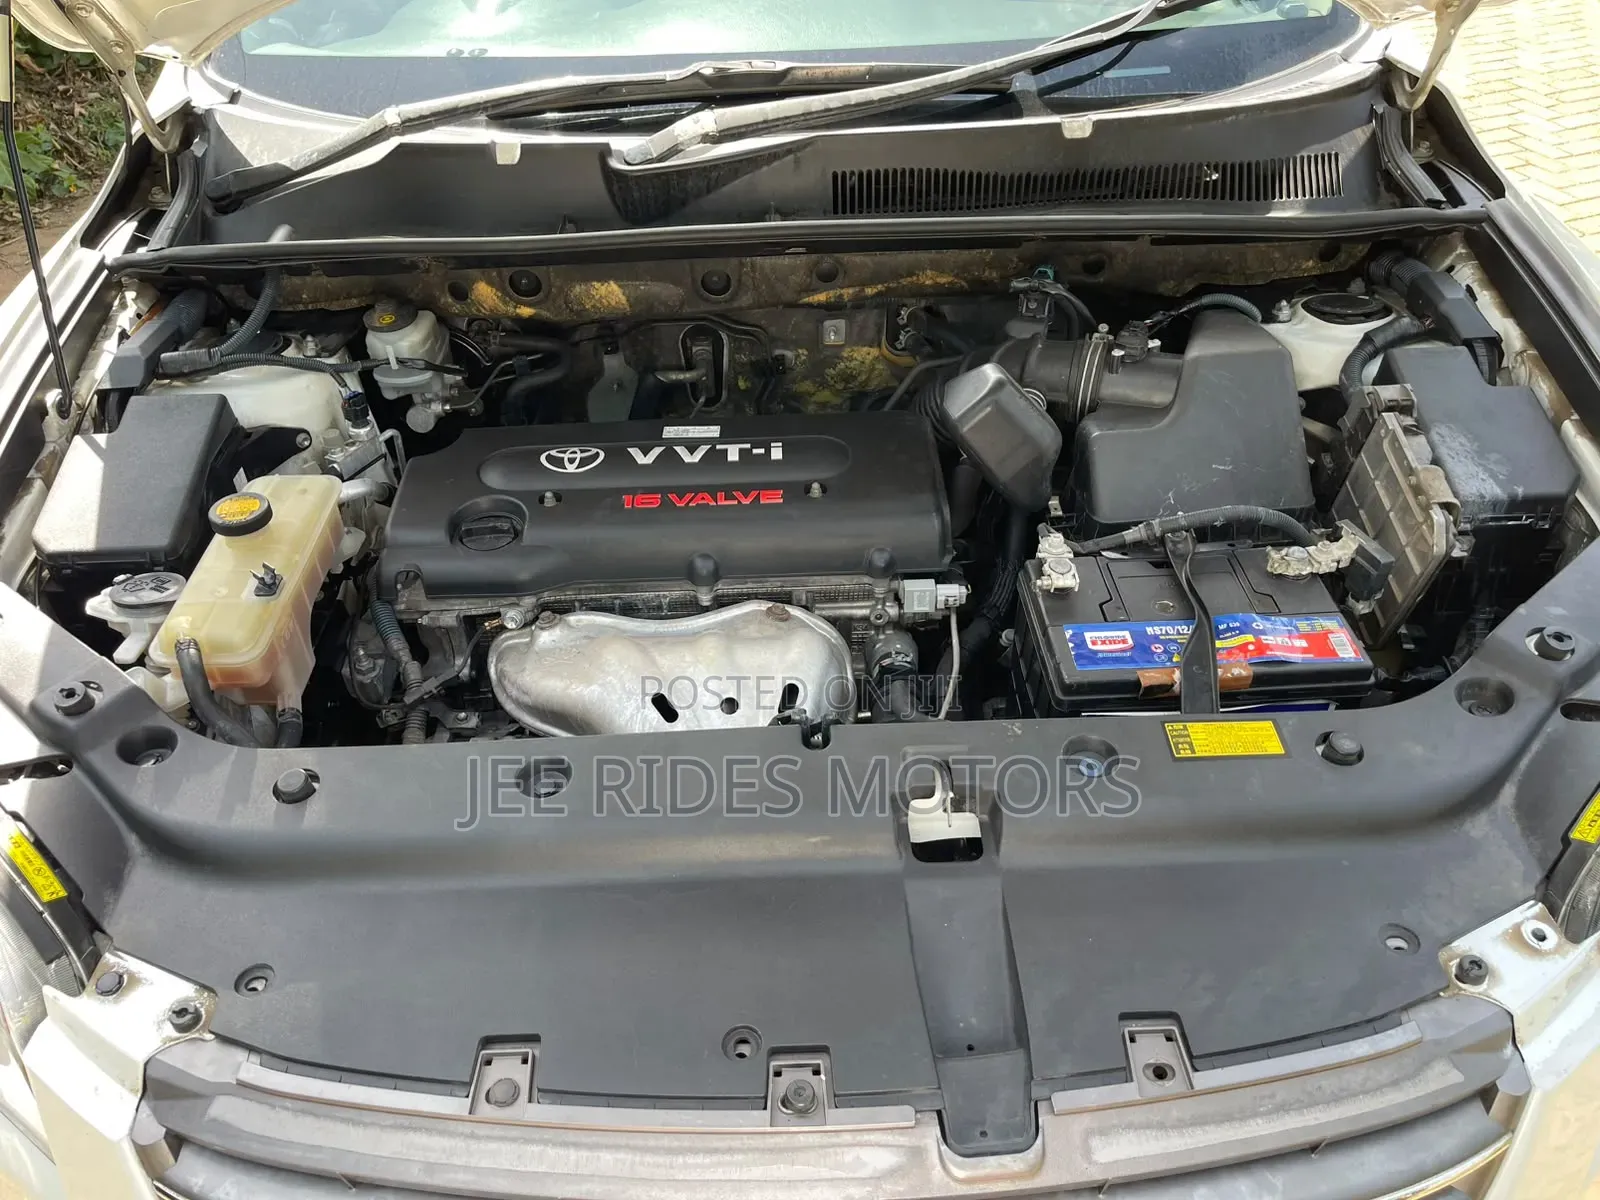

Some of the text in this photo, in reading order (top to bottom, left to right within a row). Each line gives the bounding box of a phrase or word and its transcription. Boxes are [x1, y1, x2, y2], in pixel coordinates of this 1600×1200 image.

[626, 442, 783, 464] VVT-i
[622, 489, 784, 509] 16 VALVE
[1090, 638, 1130, 647] EXIDE
